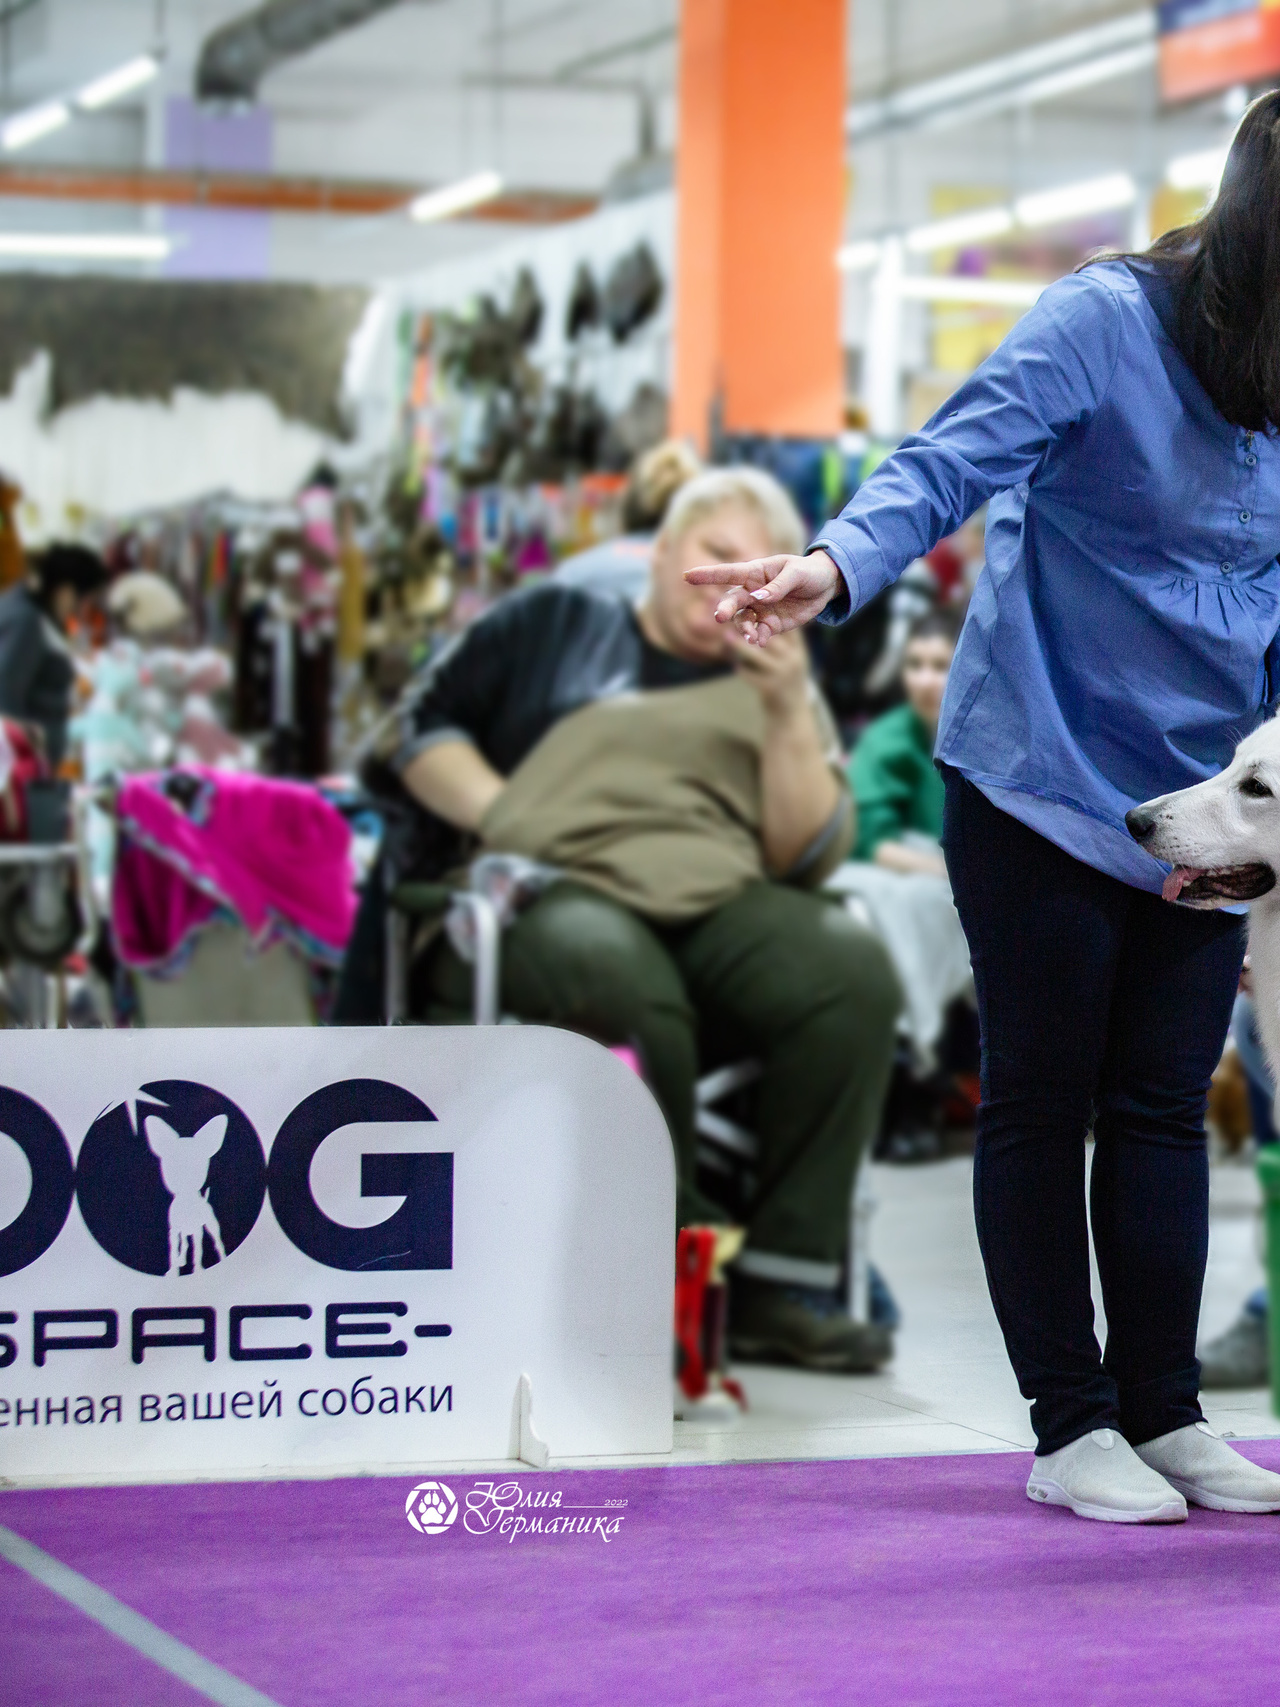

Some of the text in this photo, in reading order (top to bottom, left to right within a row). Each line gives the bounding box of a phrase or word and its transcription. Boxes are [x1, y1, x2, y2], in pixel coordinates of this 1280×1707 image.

[0, 1301, 453, 1369] PACE-
[140, 1379, 283, 1422] вашей
[298, 1375, 454, 1418] собаки
